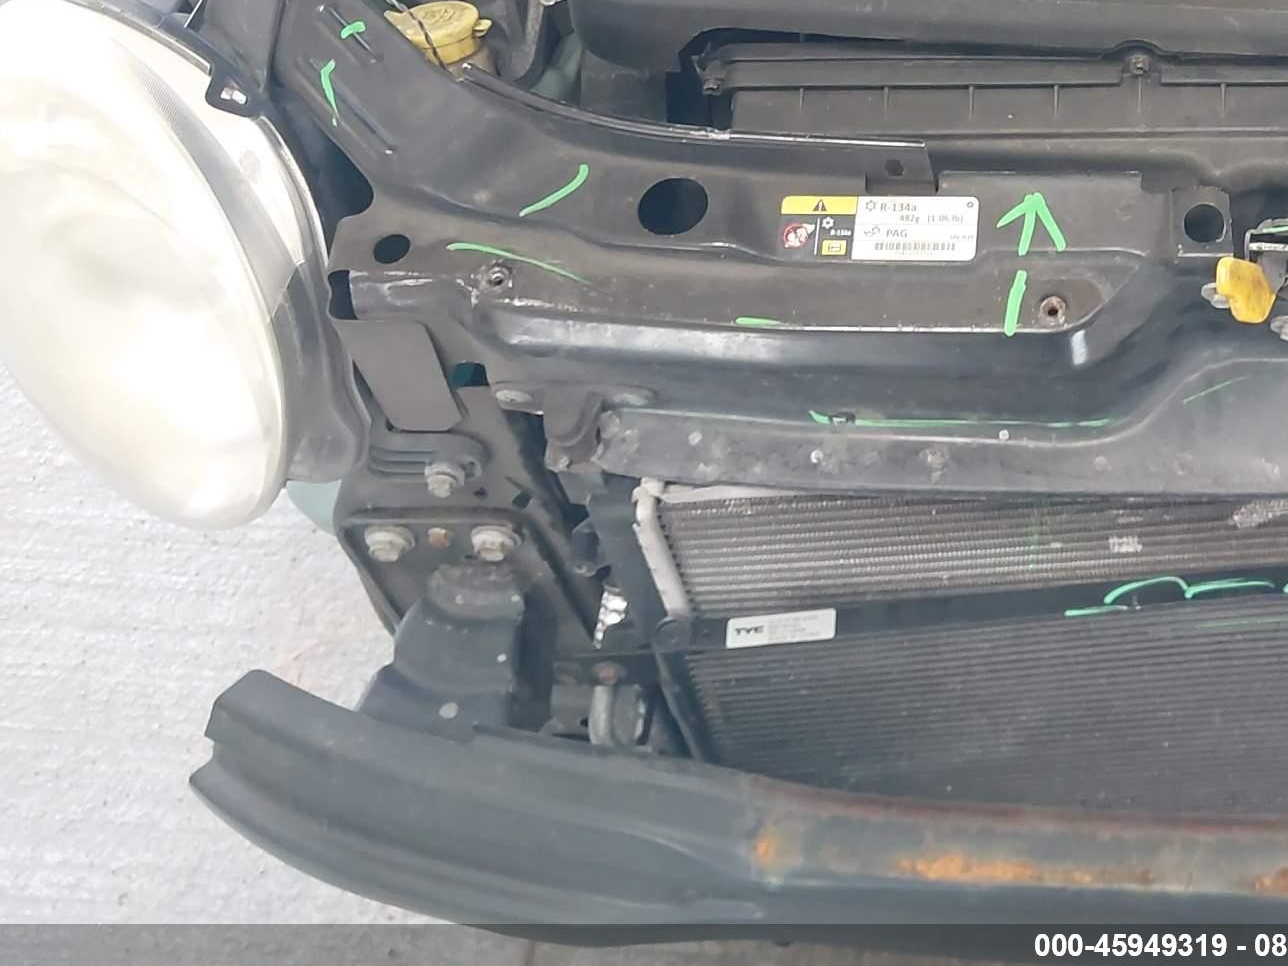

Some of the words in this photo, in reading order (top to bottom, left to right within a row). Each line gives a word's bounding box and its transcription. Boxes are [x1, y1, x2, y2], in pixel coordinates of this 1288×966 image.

[879, 201, 917, 213] R-134a
[899, 215, 921, 224] 482g
[886, 228, 909, 239] PAG
